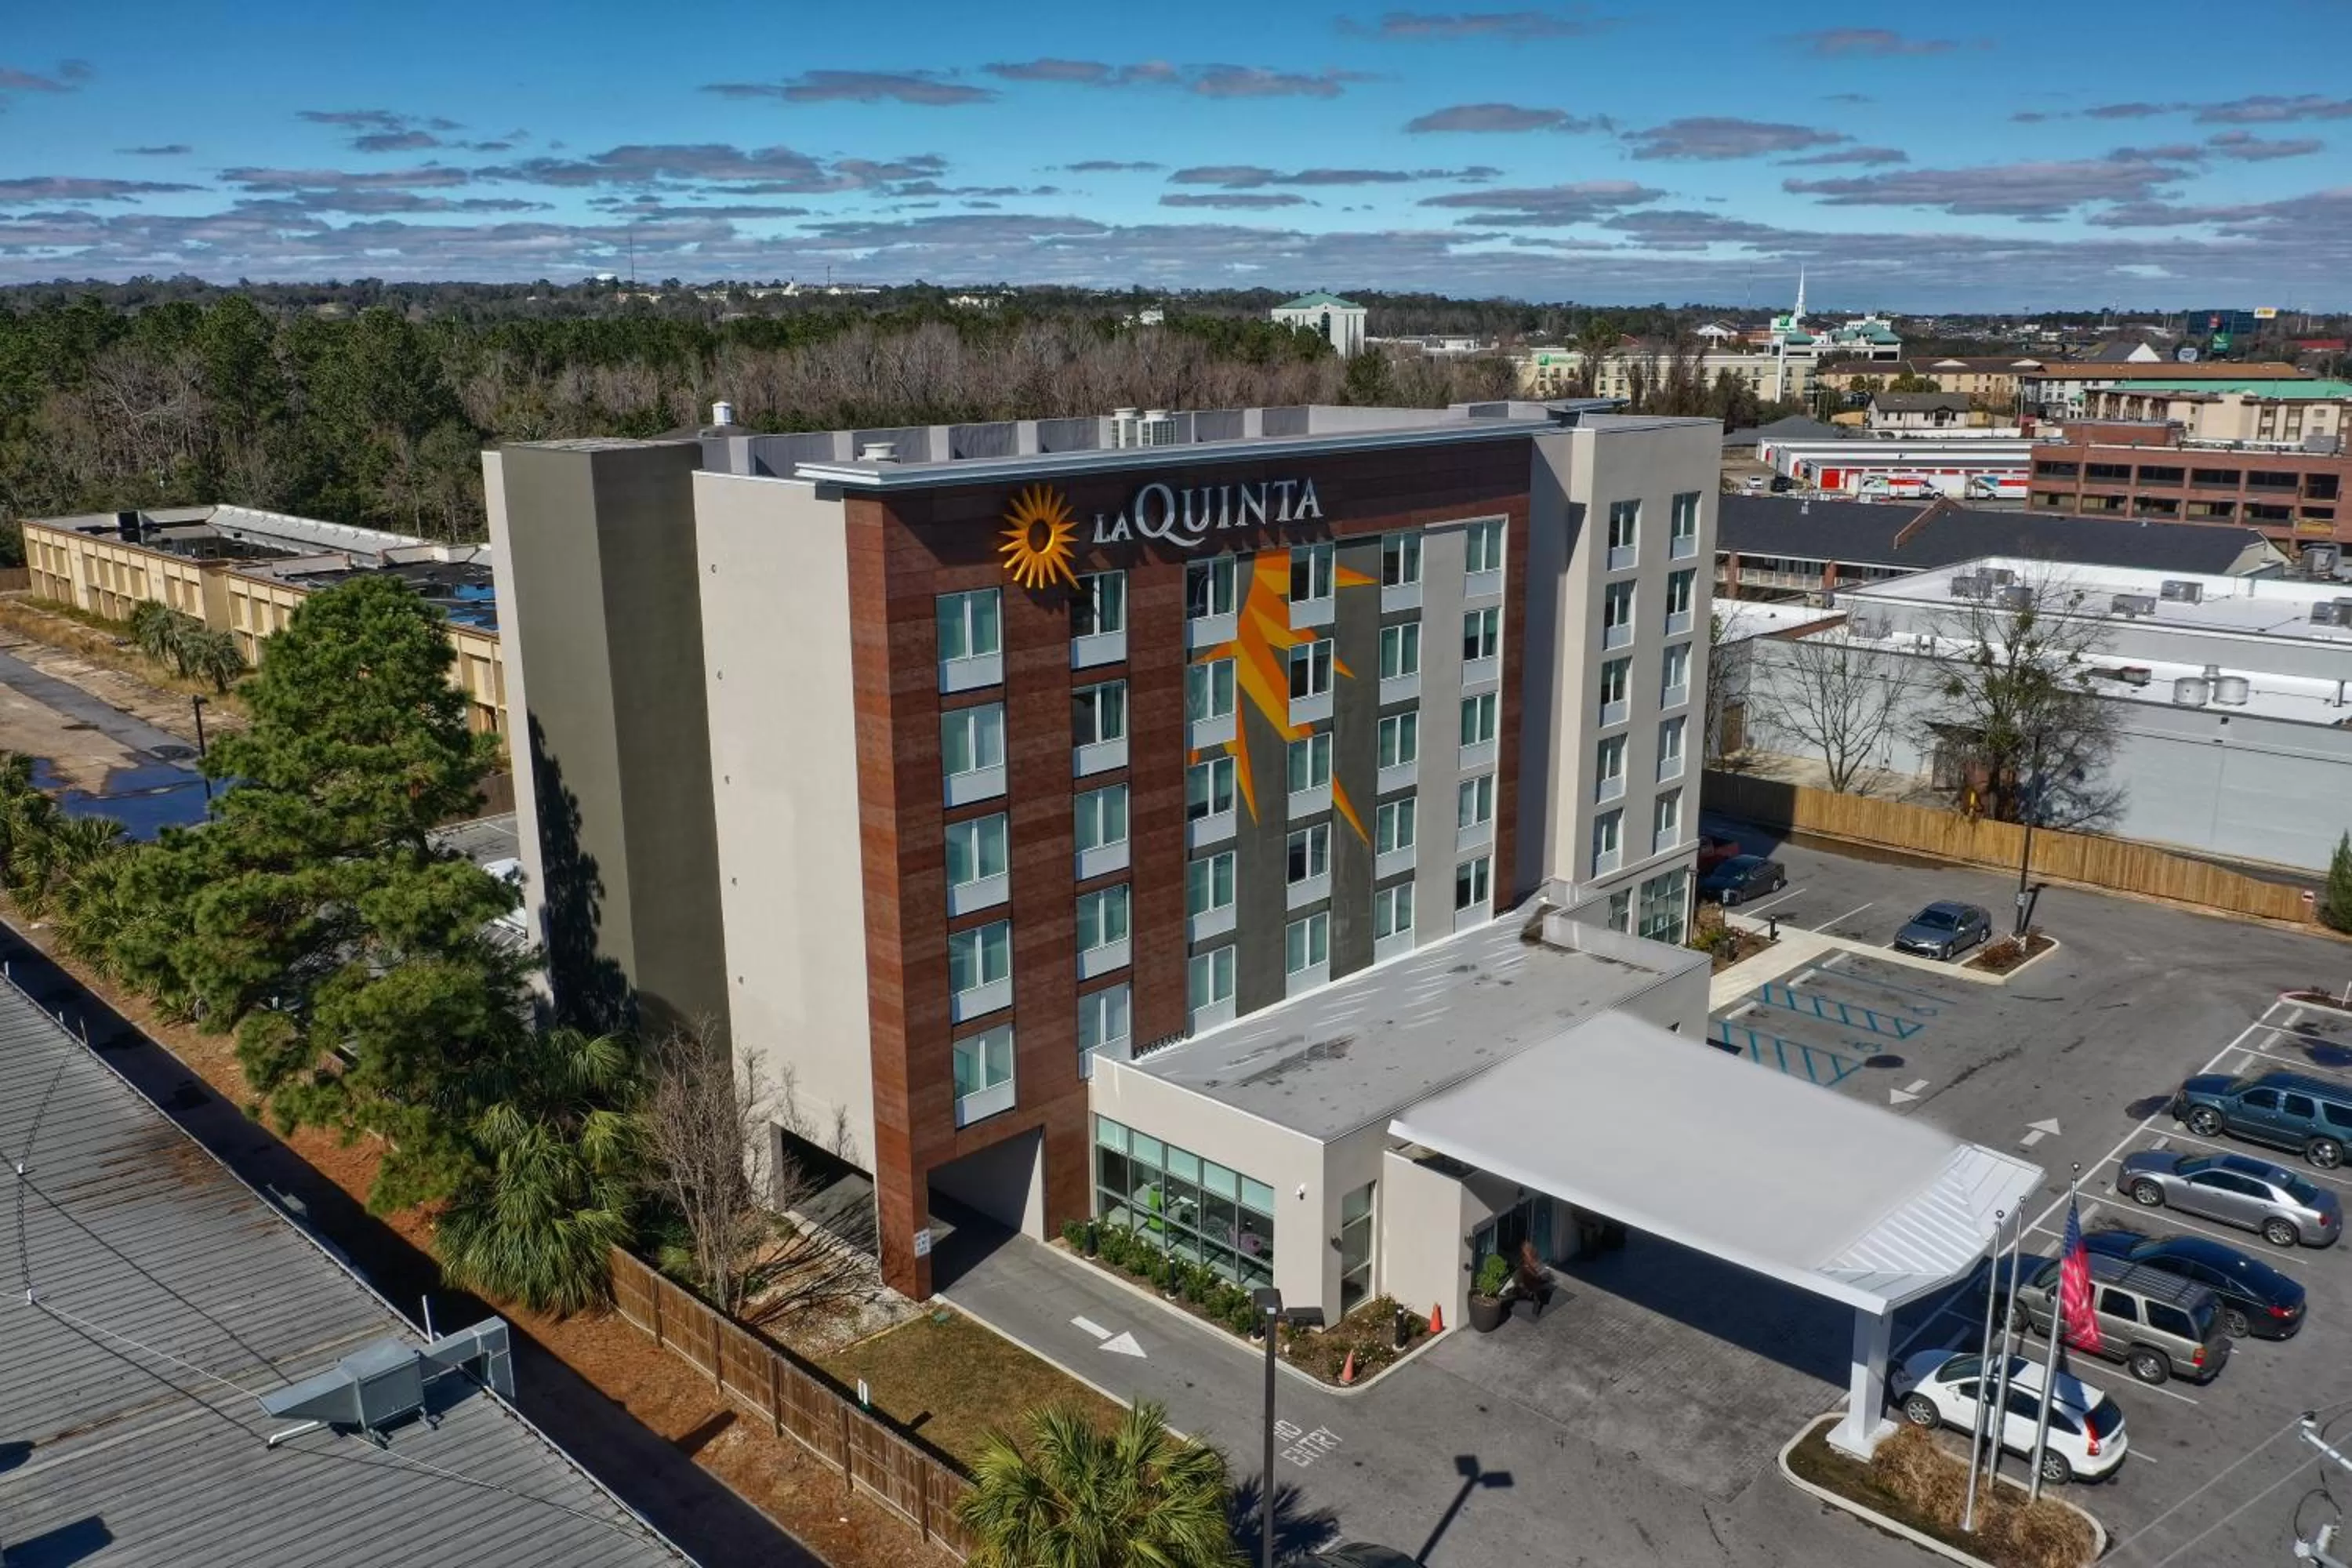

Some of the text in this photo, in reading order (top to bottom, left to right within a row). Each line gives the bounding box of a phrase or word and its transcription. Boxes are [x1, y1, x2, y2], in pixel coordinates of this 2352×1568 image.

[1091, 477, 1323, 546] LA QUINTA
[1279, 1425, 1343, 1468] ENTRY
